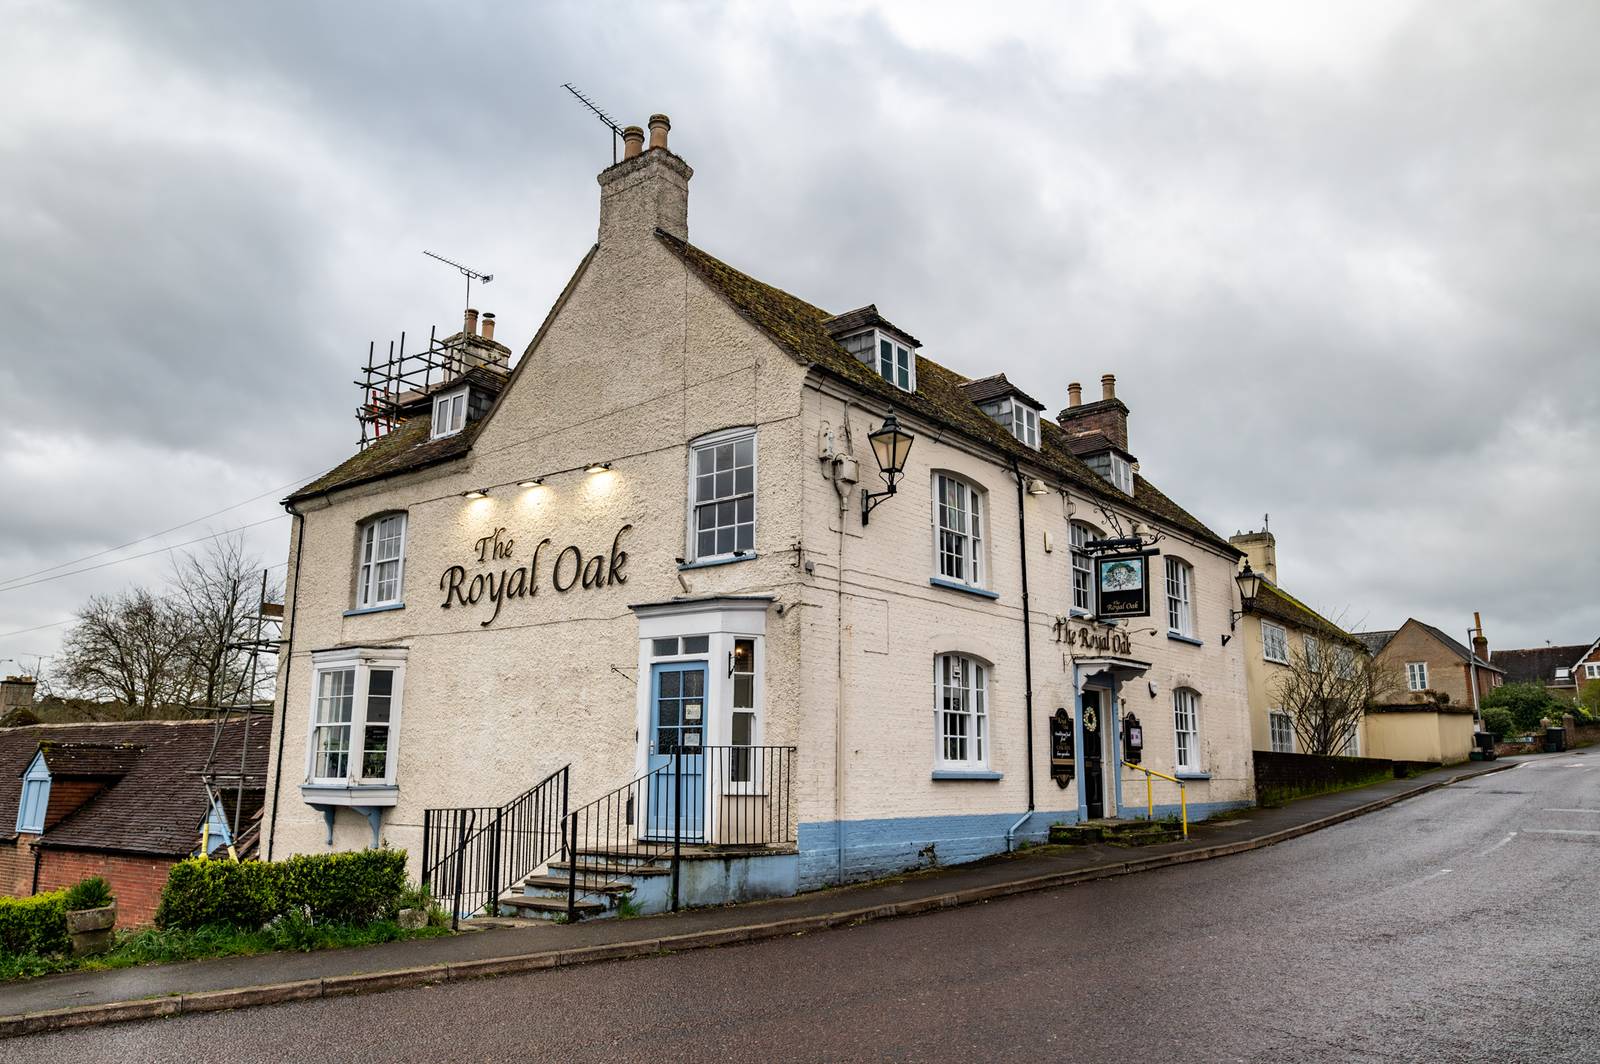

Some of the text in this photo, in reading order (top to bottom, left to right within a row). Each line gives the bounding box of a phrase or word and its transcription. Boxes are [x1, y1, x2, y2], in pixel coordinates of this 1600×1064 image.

[474, 527, 514, 562] The
[439, 524, 633, 628] Royal Oak
[1126, 600, 1139, 610] Oak
[1053, 618, 1132, 656] The Royal Oak
